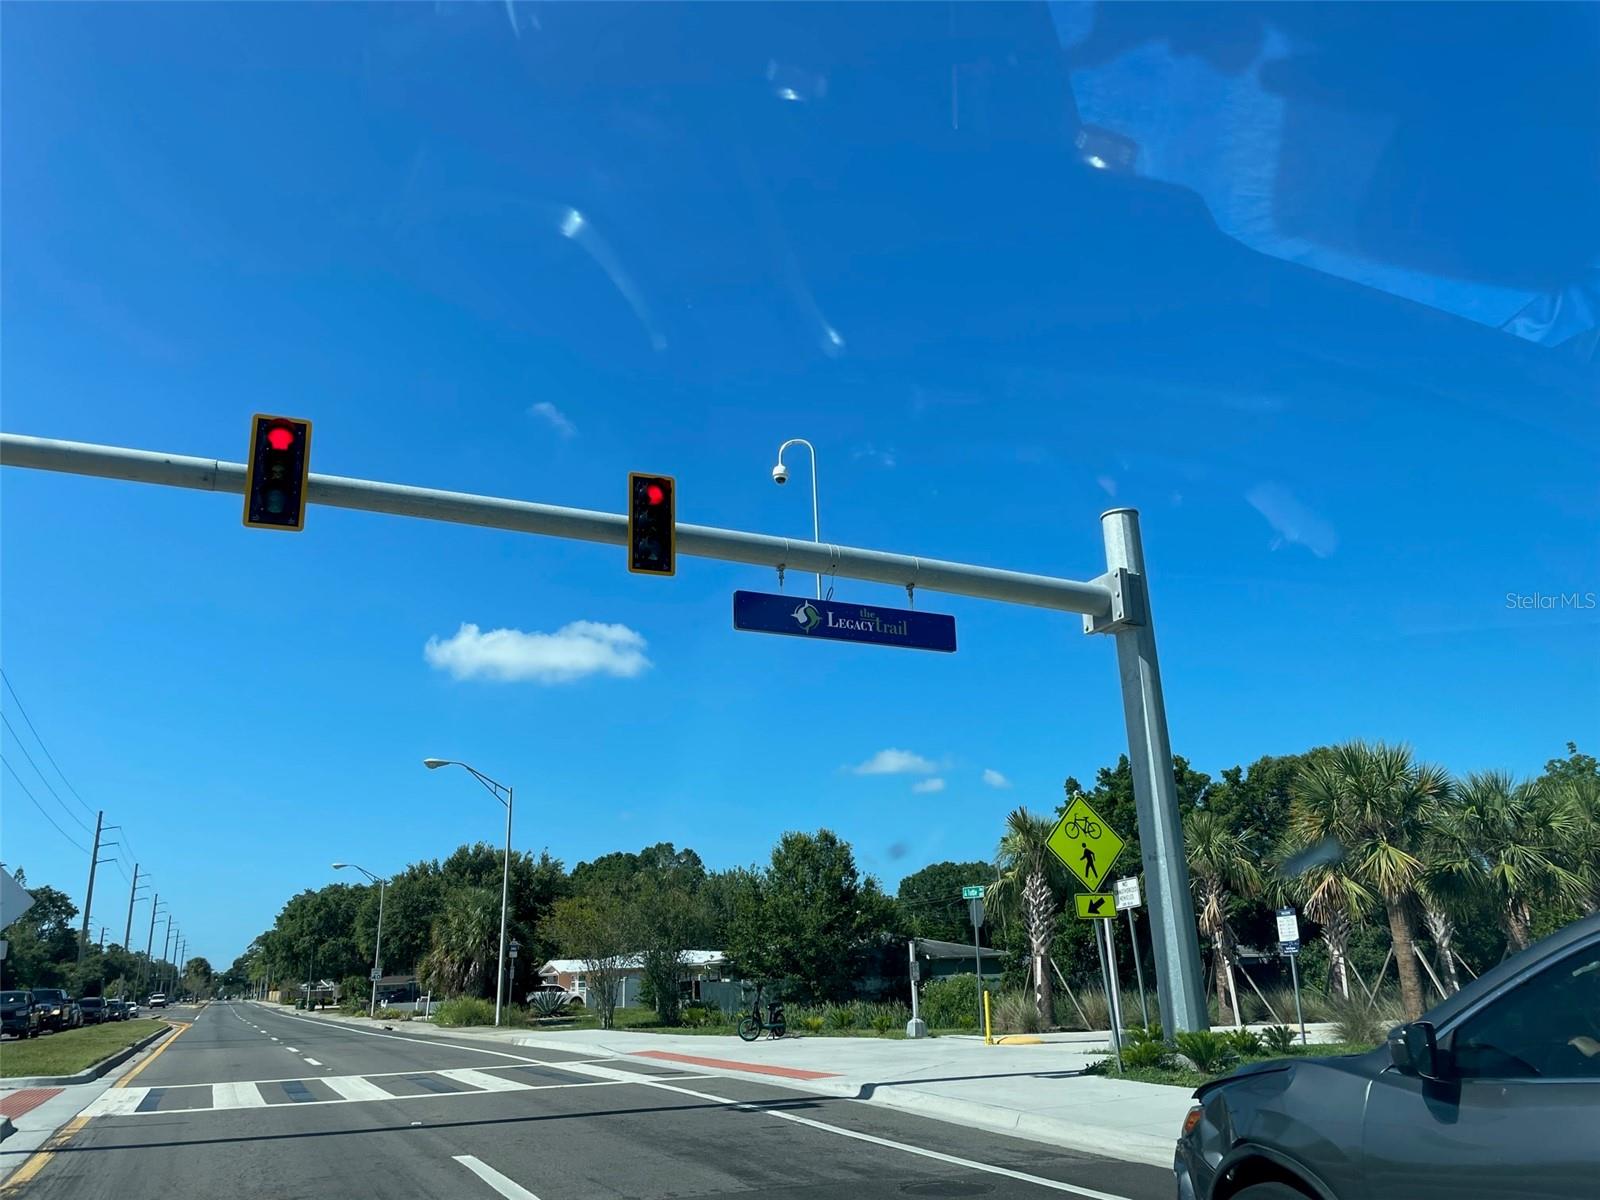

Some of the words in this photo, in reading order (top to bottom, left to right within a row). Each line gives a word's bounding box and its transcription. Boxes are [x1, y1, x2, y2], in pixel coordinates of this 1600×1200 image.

[860, 608, 876, 619] the
[826, 611, 875, 632] LEGACY
[875, 617, 908, 636] trail
